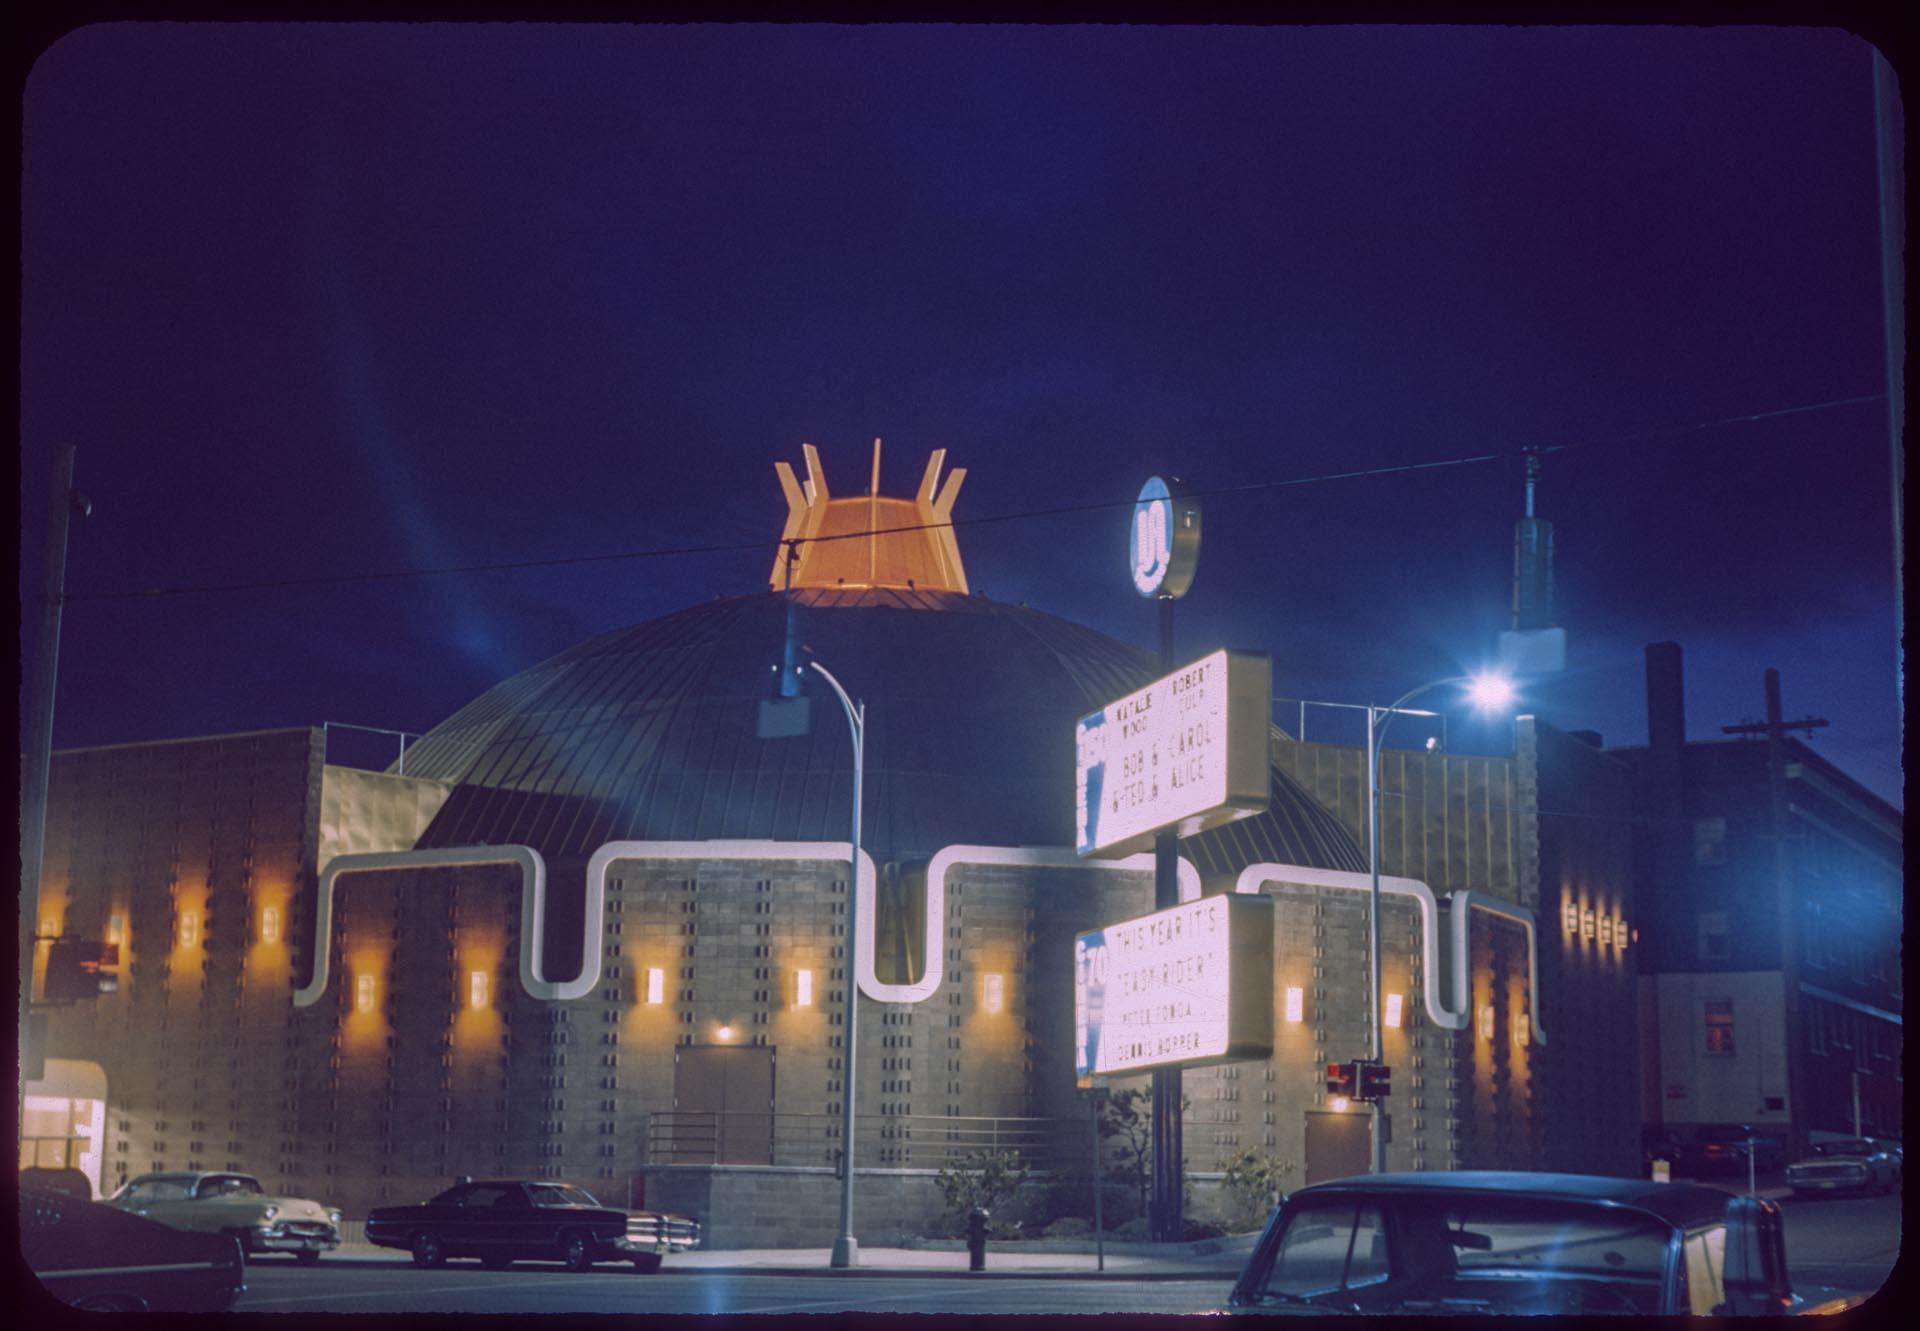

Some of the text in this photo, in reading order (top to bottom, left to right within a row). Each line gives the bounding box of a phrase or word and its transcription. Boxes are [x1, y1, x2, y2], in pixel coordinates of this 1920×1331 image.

[1172, 663, 1212, 695] ROBERT
[1123, 749, 1143, 778] BOB
[1168, 720, 1212, 758] CAROL
[1171, 754, 1205, 791] ALICE
[1116, 906, 1216, 950] THIS YEAR IT'S
[1157, 1032, 1200, 1055] HOPPER
